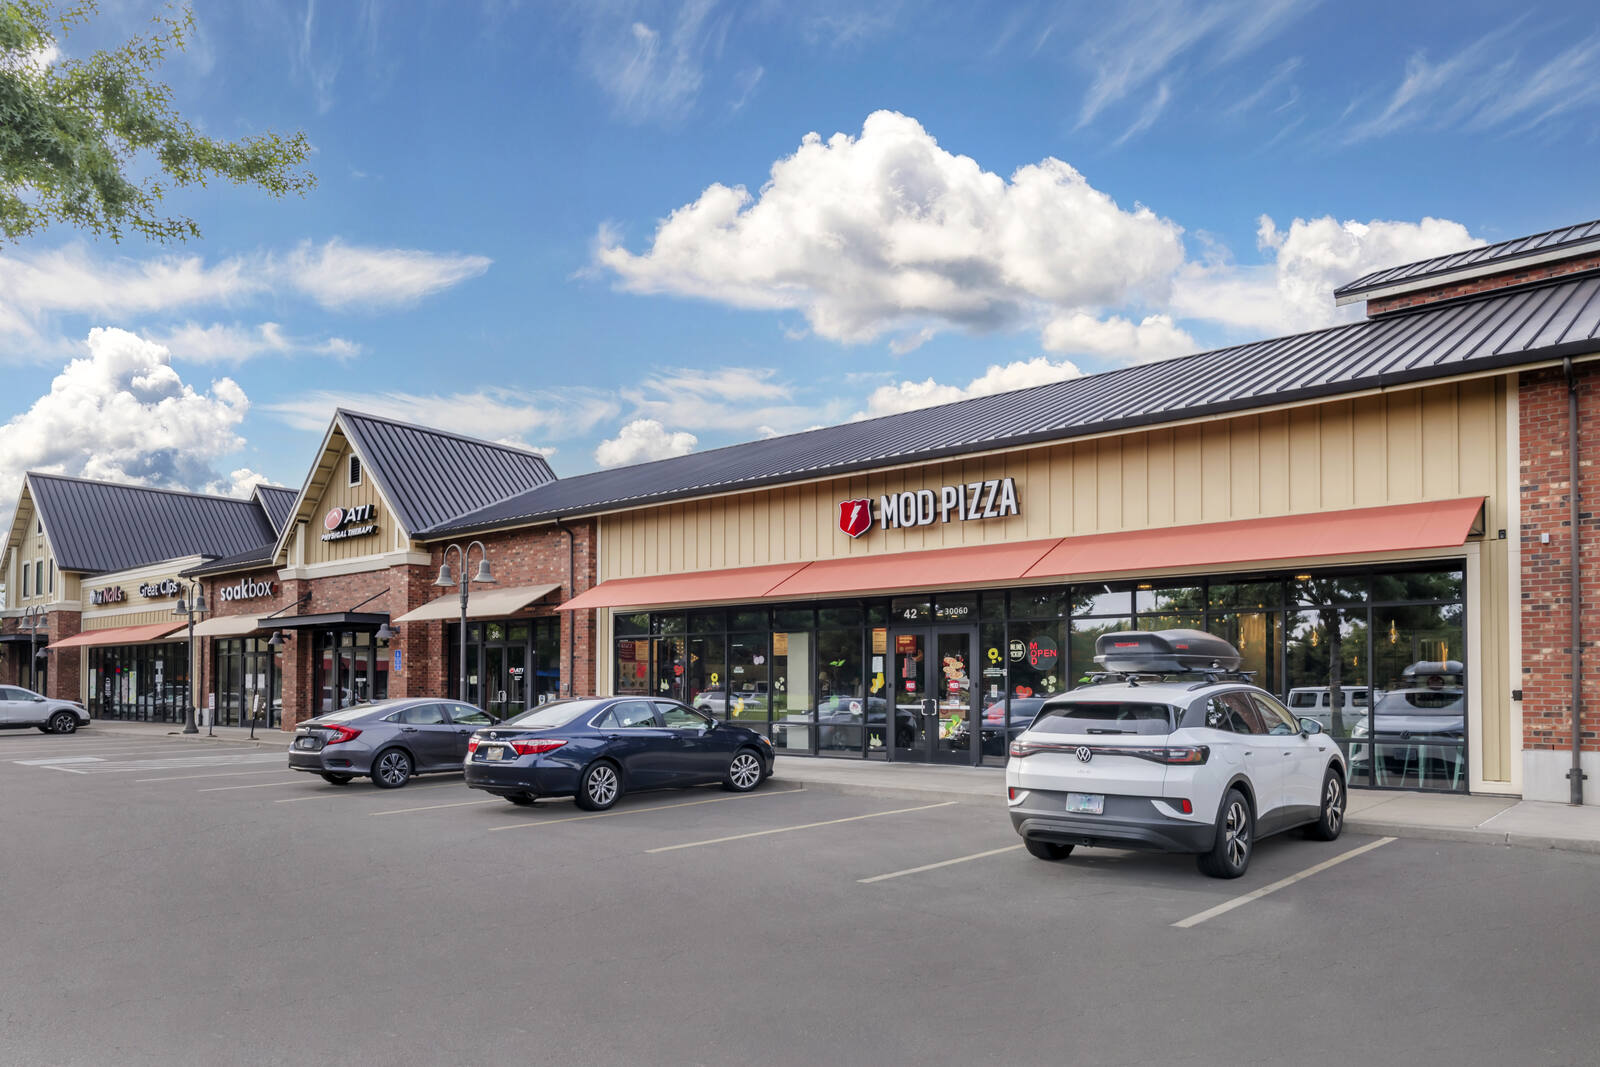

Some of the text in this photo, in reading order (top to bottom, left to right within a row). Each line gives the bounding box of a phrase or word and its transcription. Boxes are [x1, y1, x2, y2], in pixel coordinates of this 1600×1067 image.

[880, 478, 1019, 530] MOD PIZZA
[343, 504, 371, 524] ATI
[321, 525, 374, 541] PHYSICAL THERAPY
[103, 585, 122, 603] Nails
[138, 579, 178, 598] Great Clips
[220, 577, 272, 602] soakbox
[903, 606, 969, 619] 42 30060
[1030, 649, 1057, 658] OPEN
